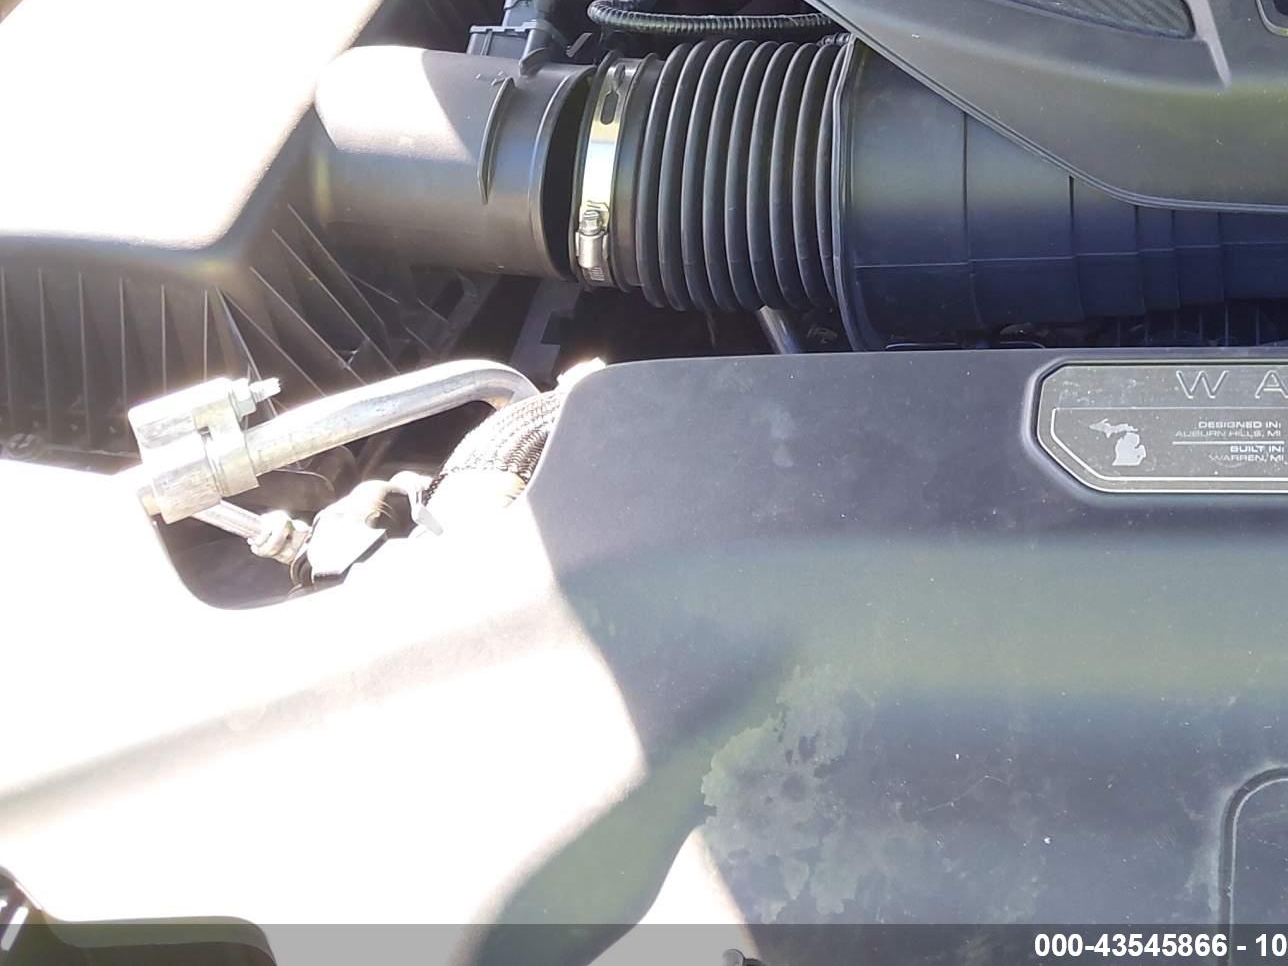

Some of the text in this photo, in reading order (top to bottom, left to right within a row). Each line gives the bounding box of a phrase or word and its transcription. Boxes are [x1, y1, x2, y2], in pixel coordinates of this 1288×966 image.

[1198, 421, 1281, 429] DESIGNED IN:
[1175, 429, 1281, 438] AUBURN HILLS, MI
[1230, 445, 1284, 453] BUILT IN:
[1208, 454, 1284, 463] WARREN, MI
